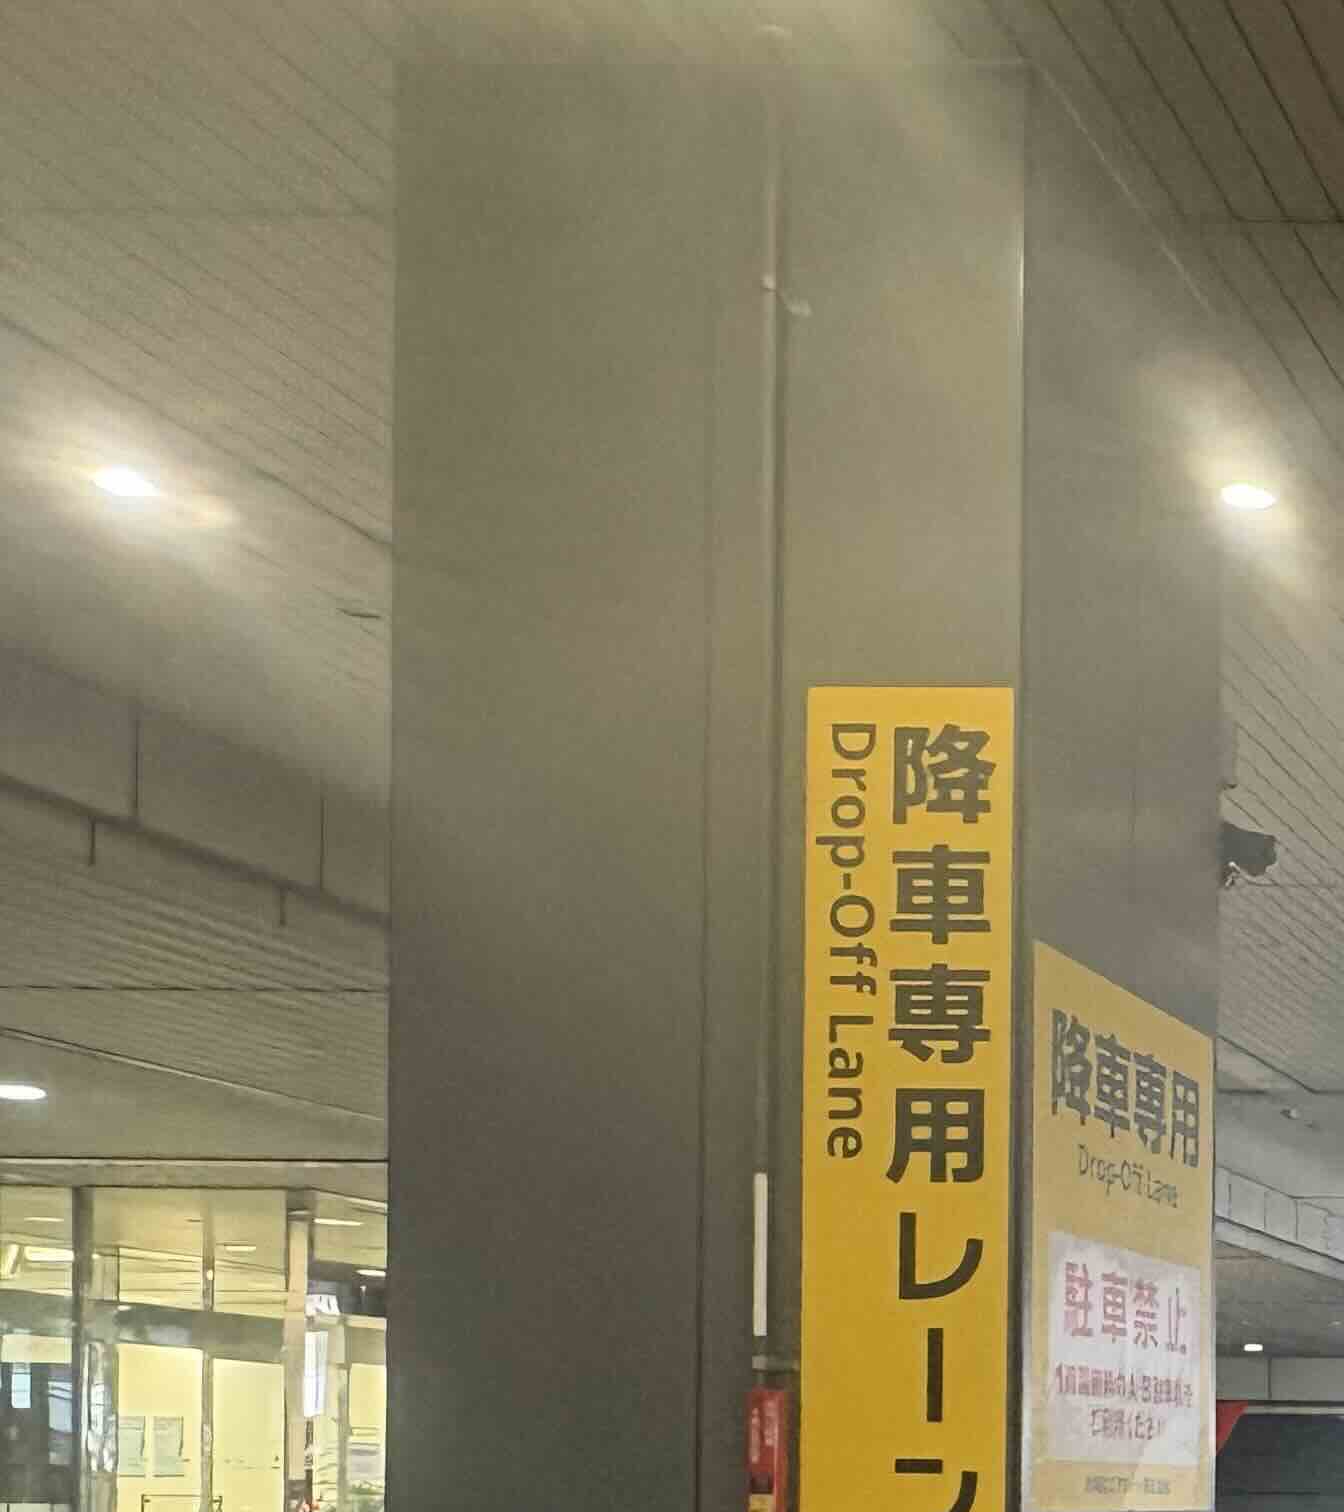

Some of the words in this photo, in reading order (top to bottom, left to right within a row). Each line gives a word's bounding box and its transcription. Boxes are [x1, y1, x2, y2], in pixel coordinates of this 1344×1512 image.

[816, 722, 878, 998] Drop-Off
[827, 1014, 875, 1160] Lane
[1052, 1008, 1199, 1168] 降車専用
